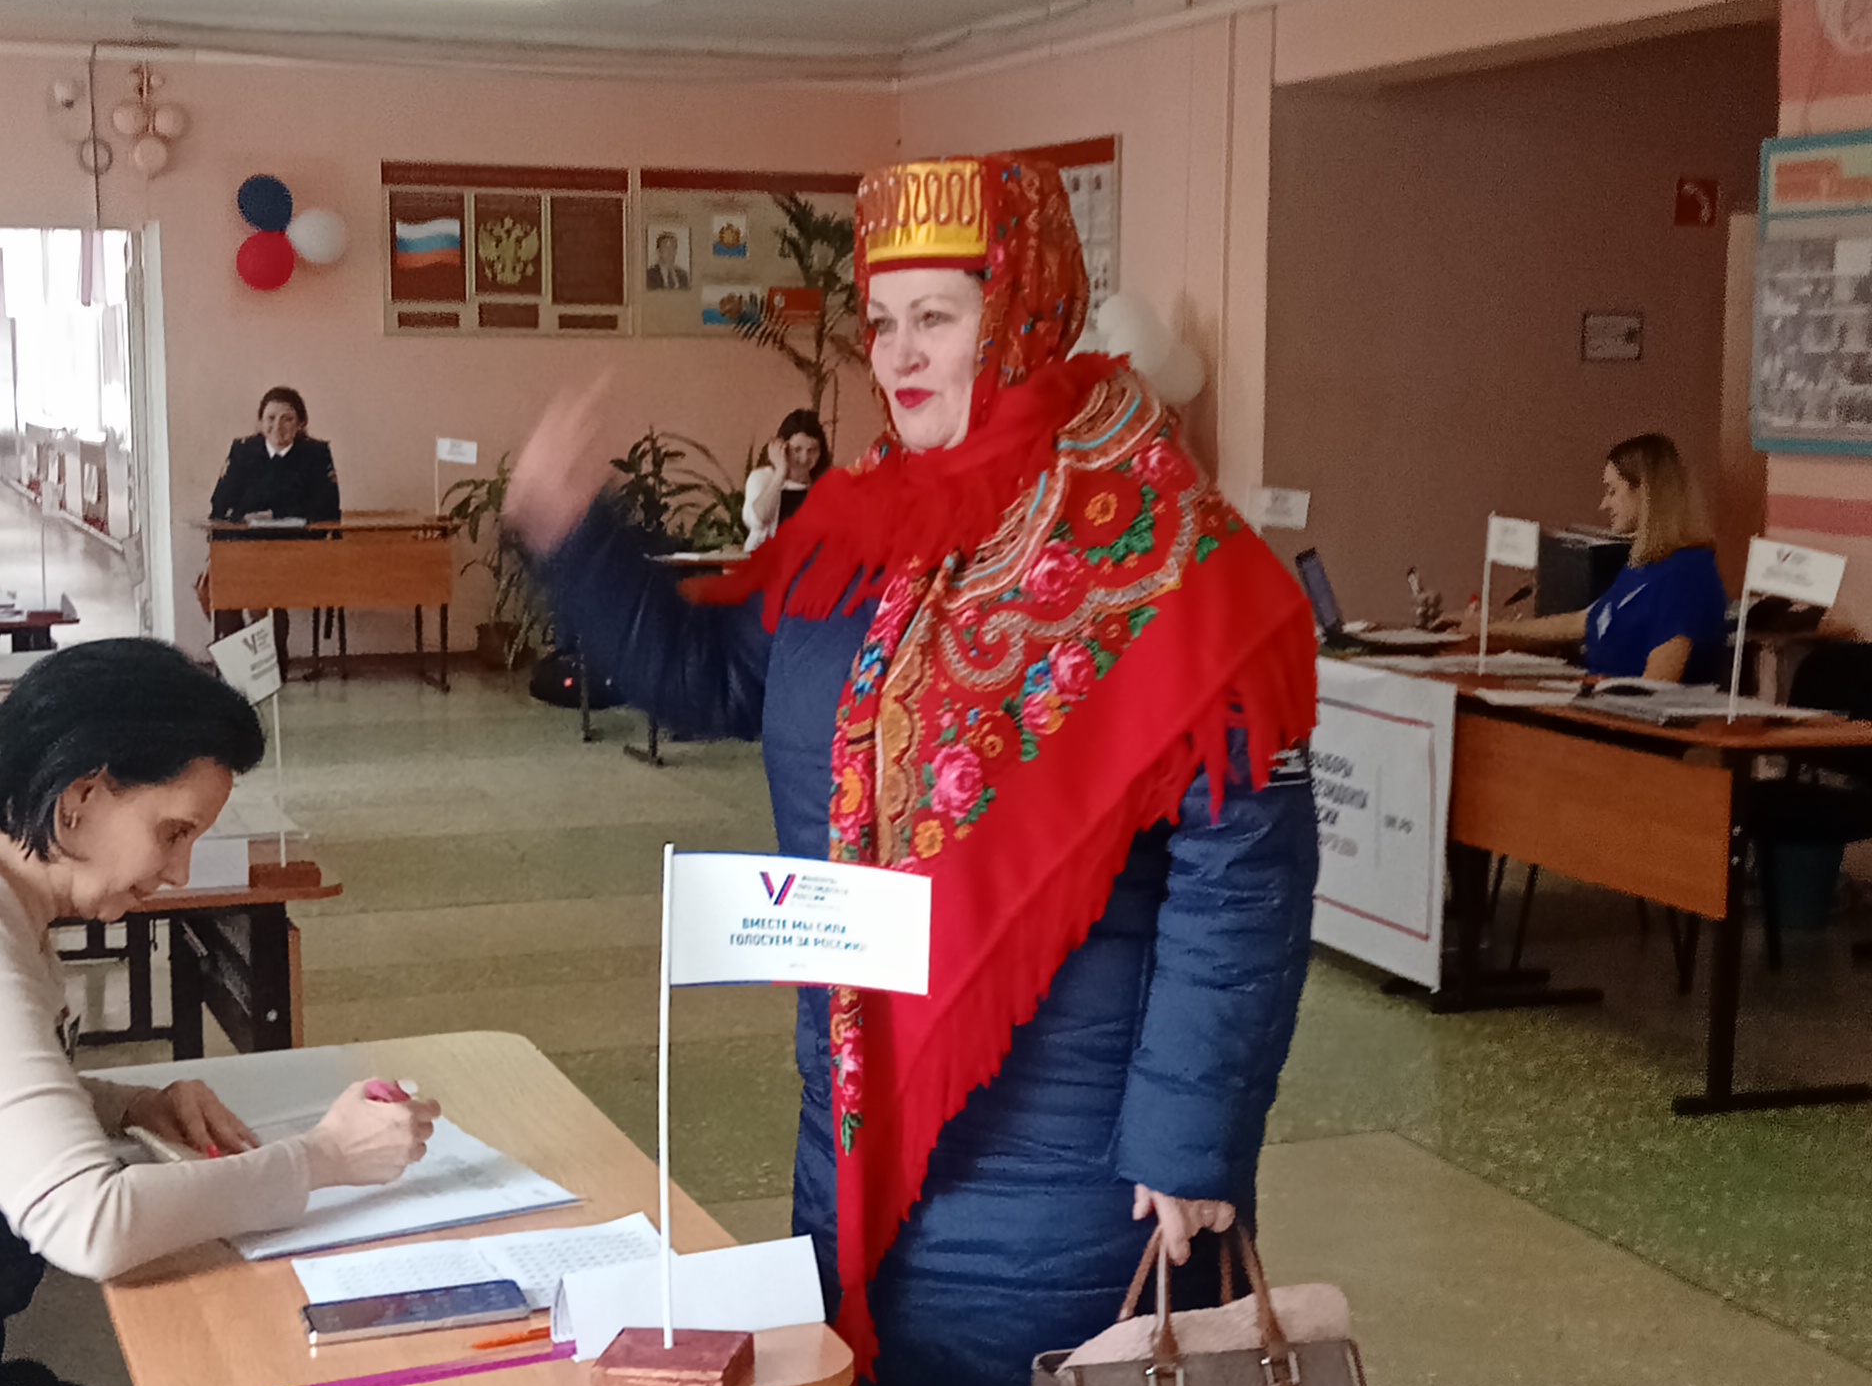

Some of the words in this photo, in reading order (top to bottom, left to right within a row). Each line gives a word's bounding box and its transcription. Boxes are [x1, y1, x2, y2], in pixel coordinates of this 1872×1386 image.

[742, 917, 787, 931] ВМЕСТЕ
[792, 919, 813, 931] МЫ
[816, 922, 847, 935] СИЛА
[729, 933, 793, 947] ГОЛОСУЕМ
[796, 936, 810, 947] ЗА
